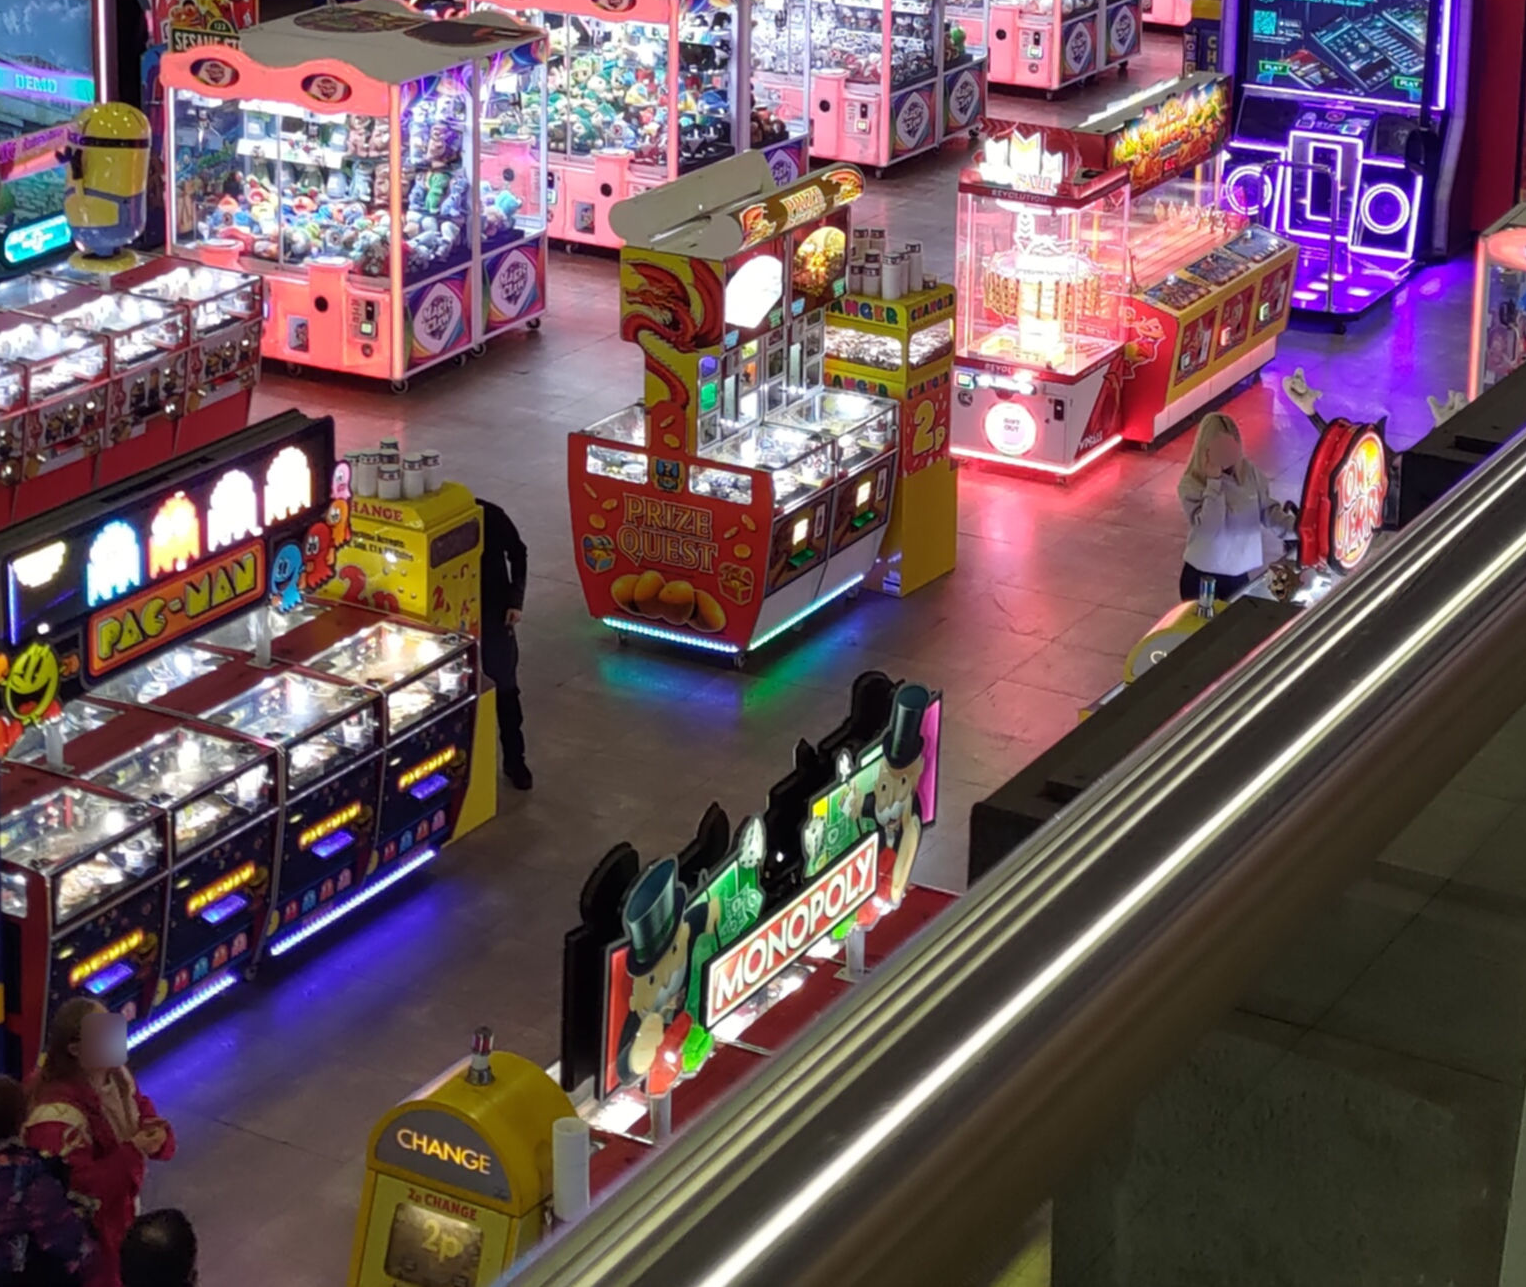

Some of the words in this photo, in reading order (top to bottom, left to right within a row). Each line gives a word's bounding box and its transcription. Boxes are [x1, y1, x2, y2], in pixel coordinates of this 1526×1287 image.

[15, 73, 58, 94] DEMO
[1399, 79, 1420, 89] PLAY
[991, 188, 1048, 203] REVOLUTION
[830, 299, 899, 325] ANGER
[912, 400, 946, 457] 2p
[351, 501, 404, 522] HANGE
[624, 492, 712, 540] PRIZE
[616, 523, 719, 573] QUEST
[95, 552, 259, 662] PAC-MAN
[714, 847, 875, 1011] MONOPOLY
[396, 1128, 492, 1175] CHANGE
[407, 1187, 424, 1203] 2p
[424, 1193, 478, 1221] CHANGE
[421, 1218, 464, 1263] 2p
